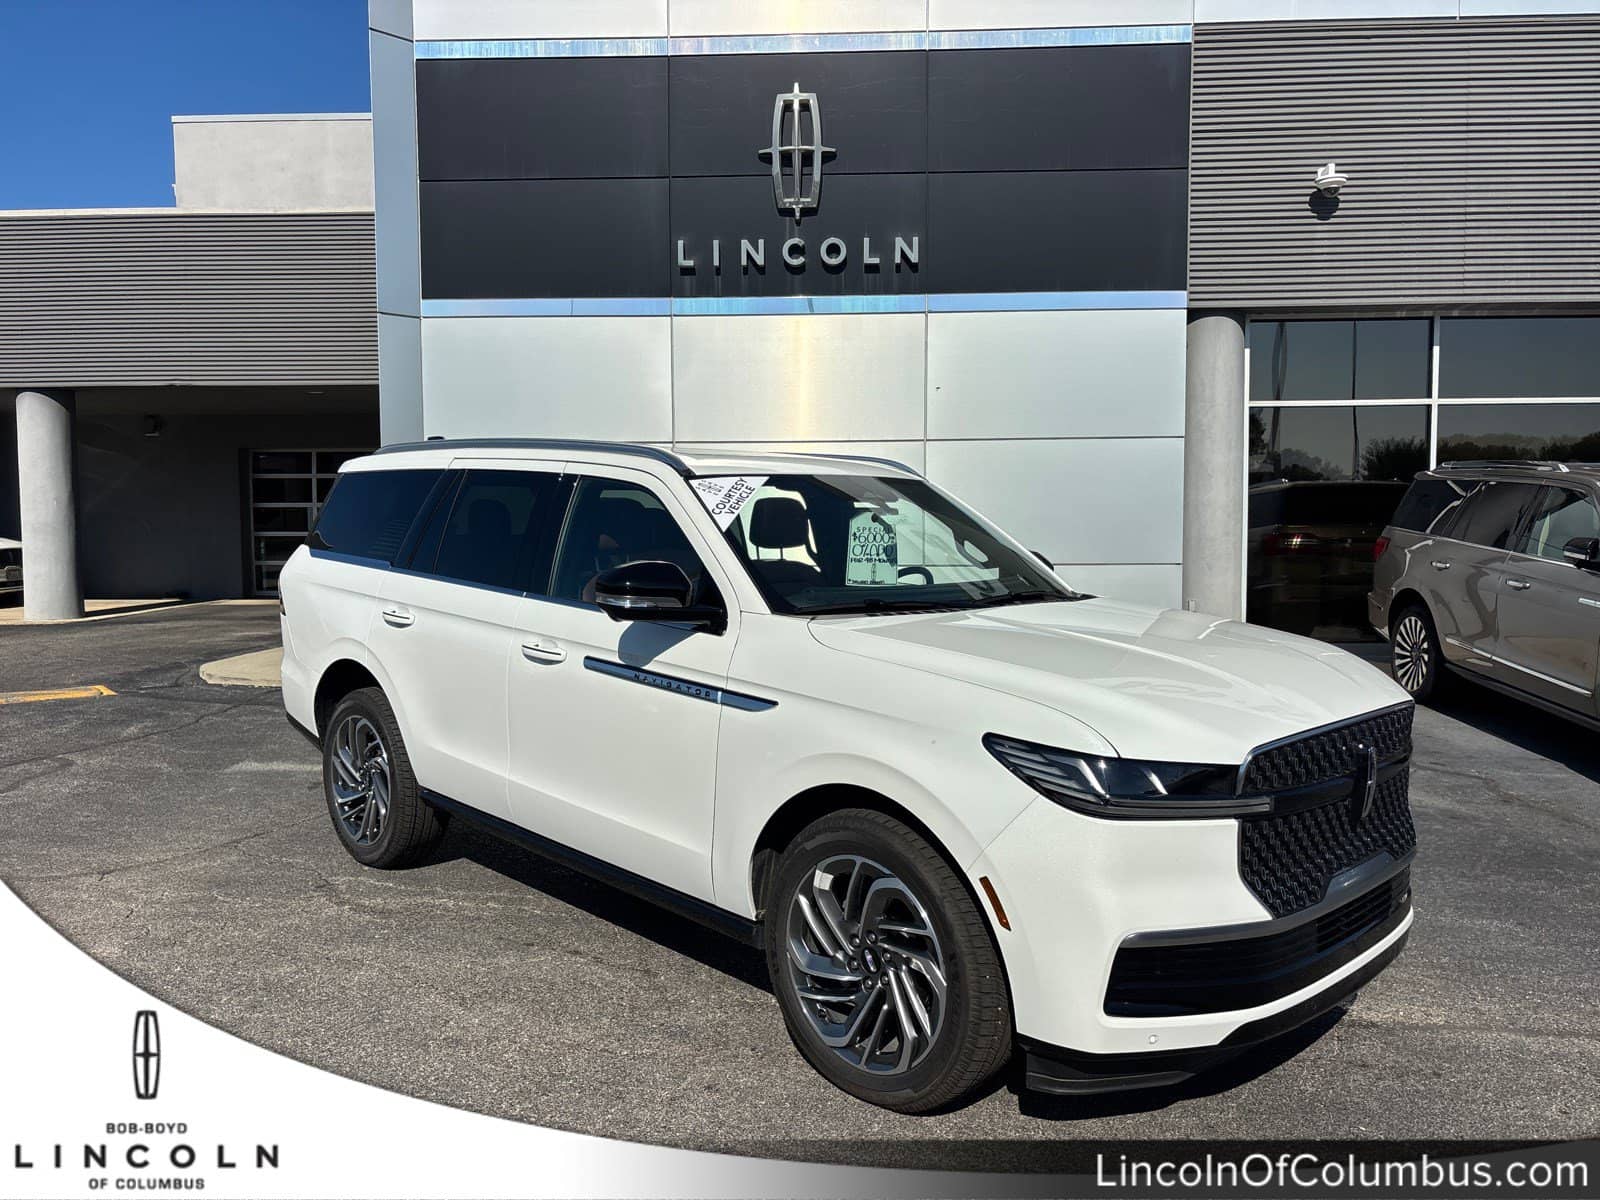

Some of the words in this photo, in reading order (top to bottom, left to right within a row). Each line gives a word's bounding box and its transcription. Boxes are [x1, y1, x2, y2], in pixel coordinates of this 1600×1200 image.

[677, 236, 920, 267] LINCOLN
[711, 477, 747, 515] COURTESY
[724, 485, 756, 515] VEHICLE
[633, 672, 711, 698] NAVIGATOR
